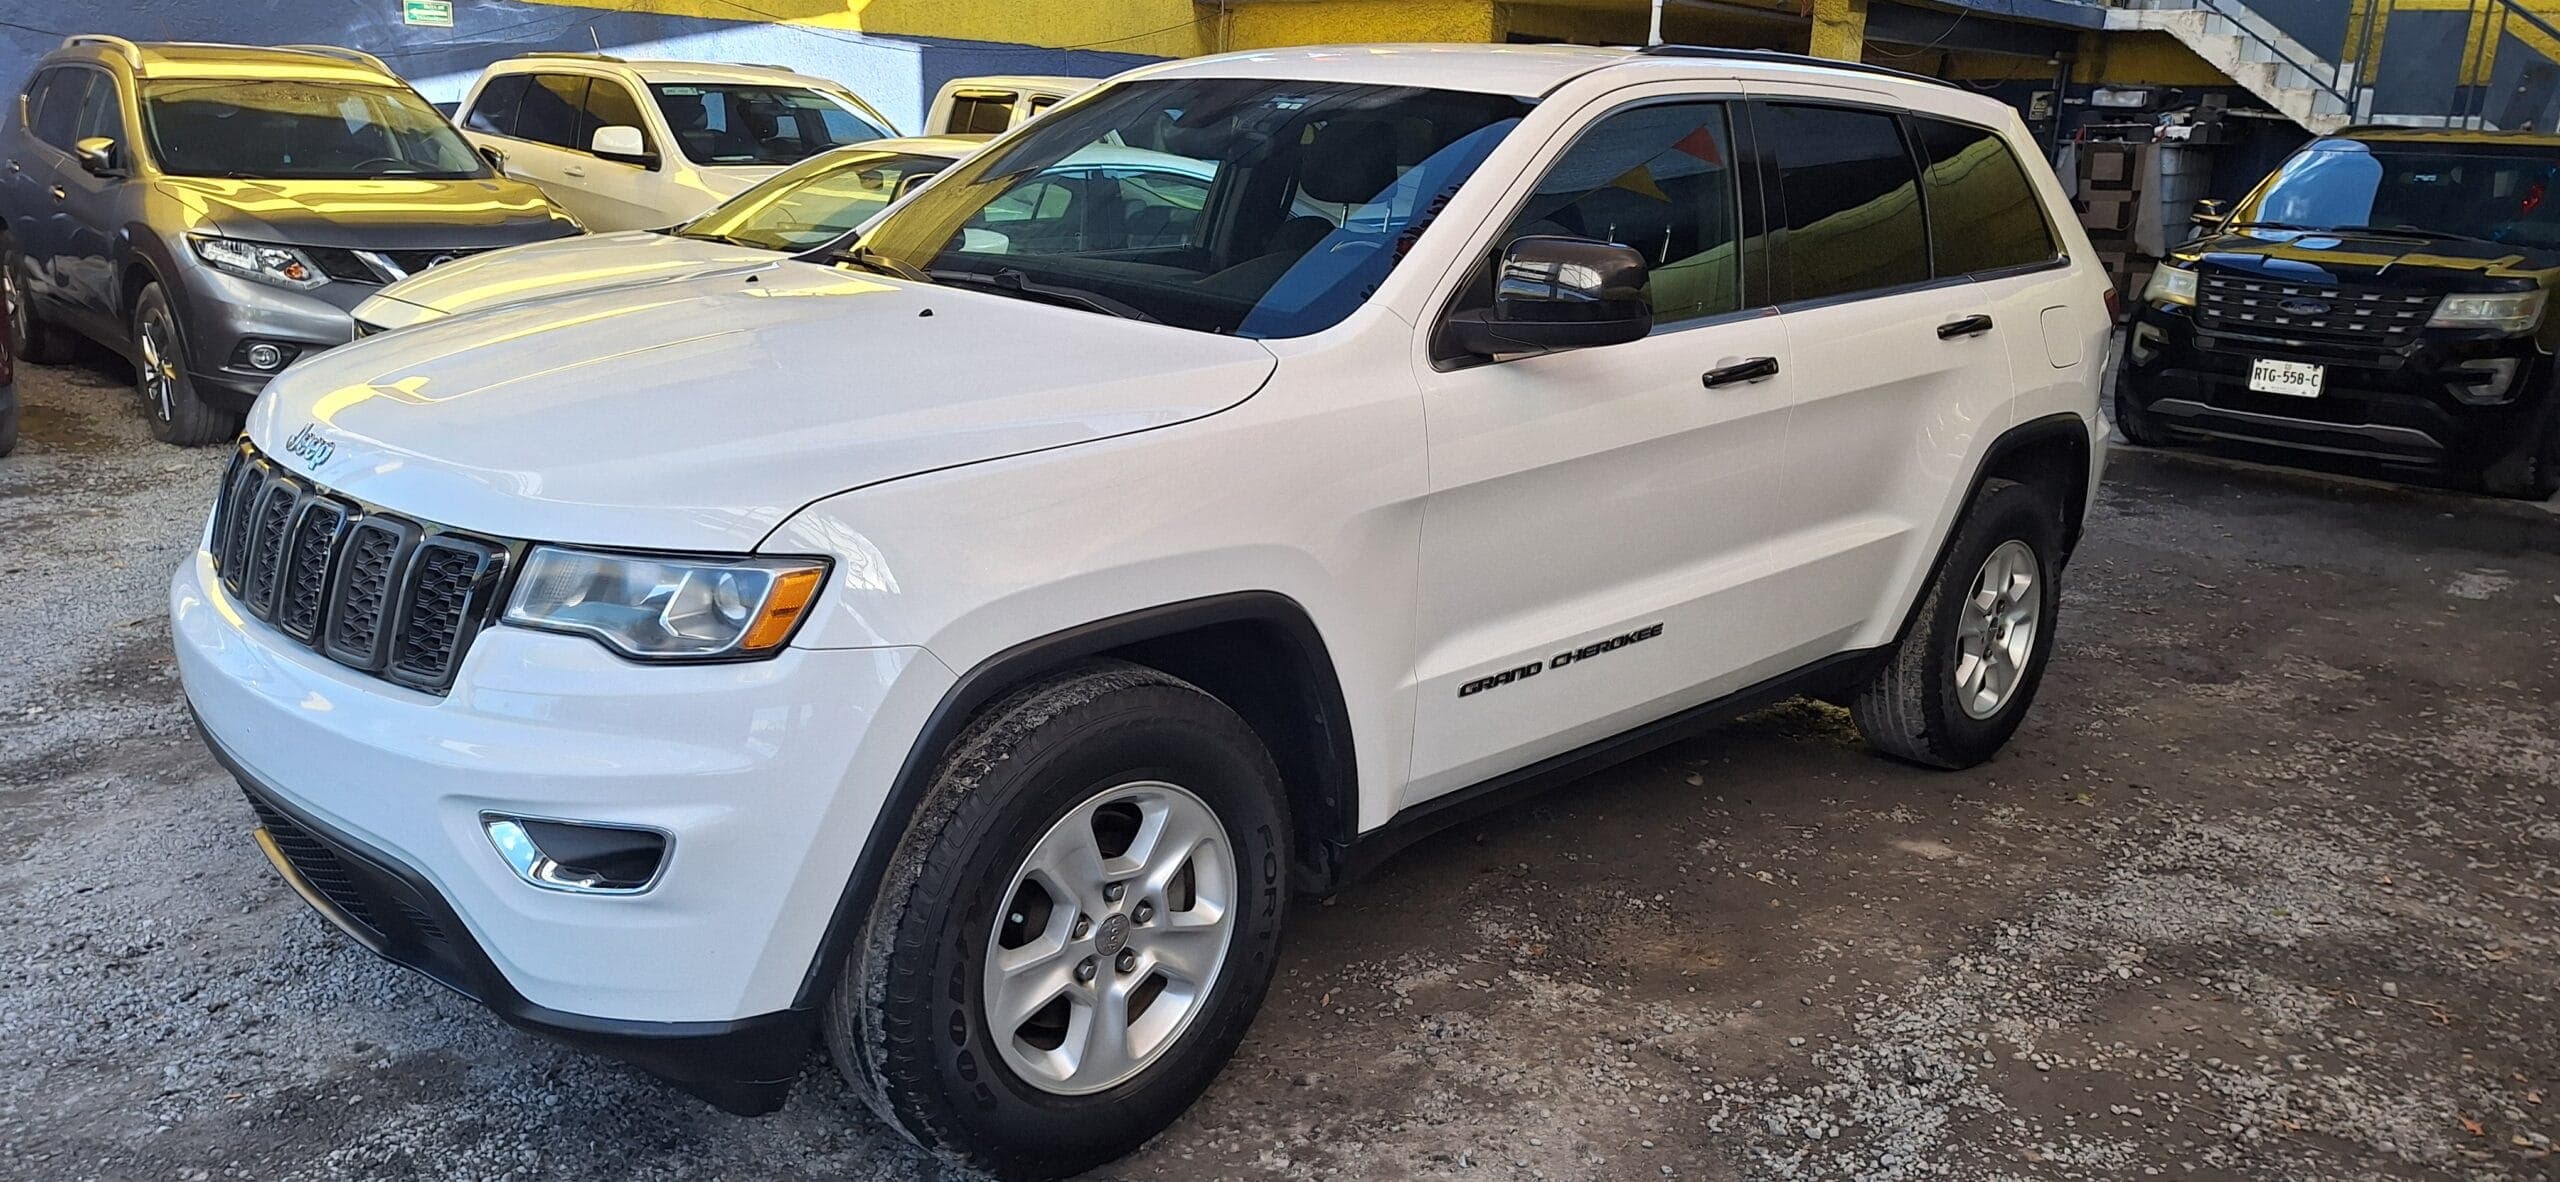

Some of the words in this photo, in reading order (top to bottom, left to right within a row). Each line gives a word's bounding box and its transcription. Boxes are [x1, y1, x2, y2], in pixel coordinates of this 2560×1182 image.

[2254, 366, 2319, 388] RTG-558-C
[286, 422, 335, 471] Jeep
[1457, 661, 1543, 697] GRAND
[1549, 622, 1664, 669] CHEROKEE
